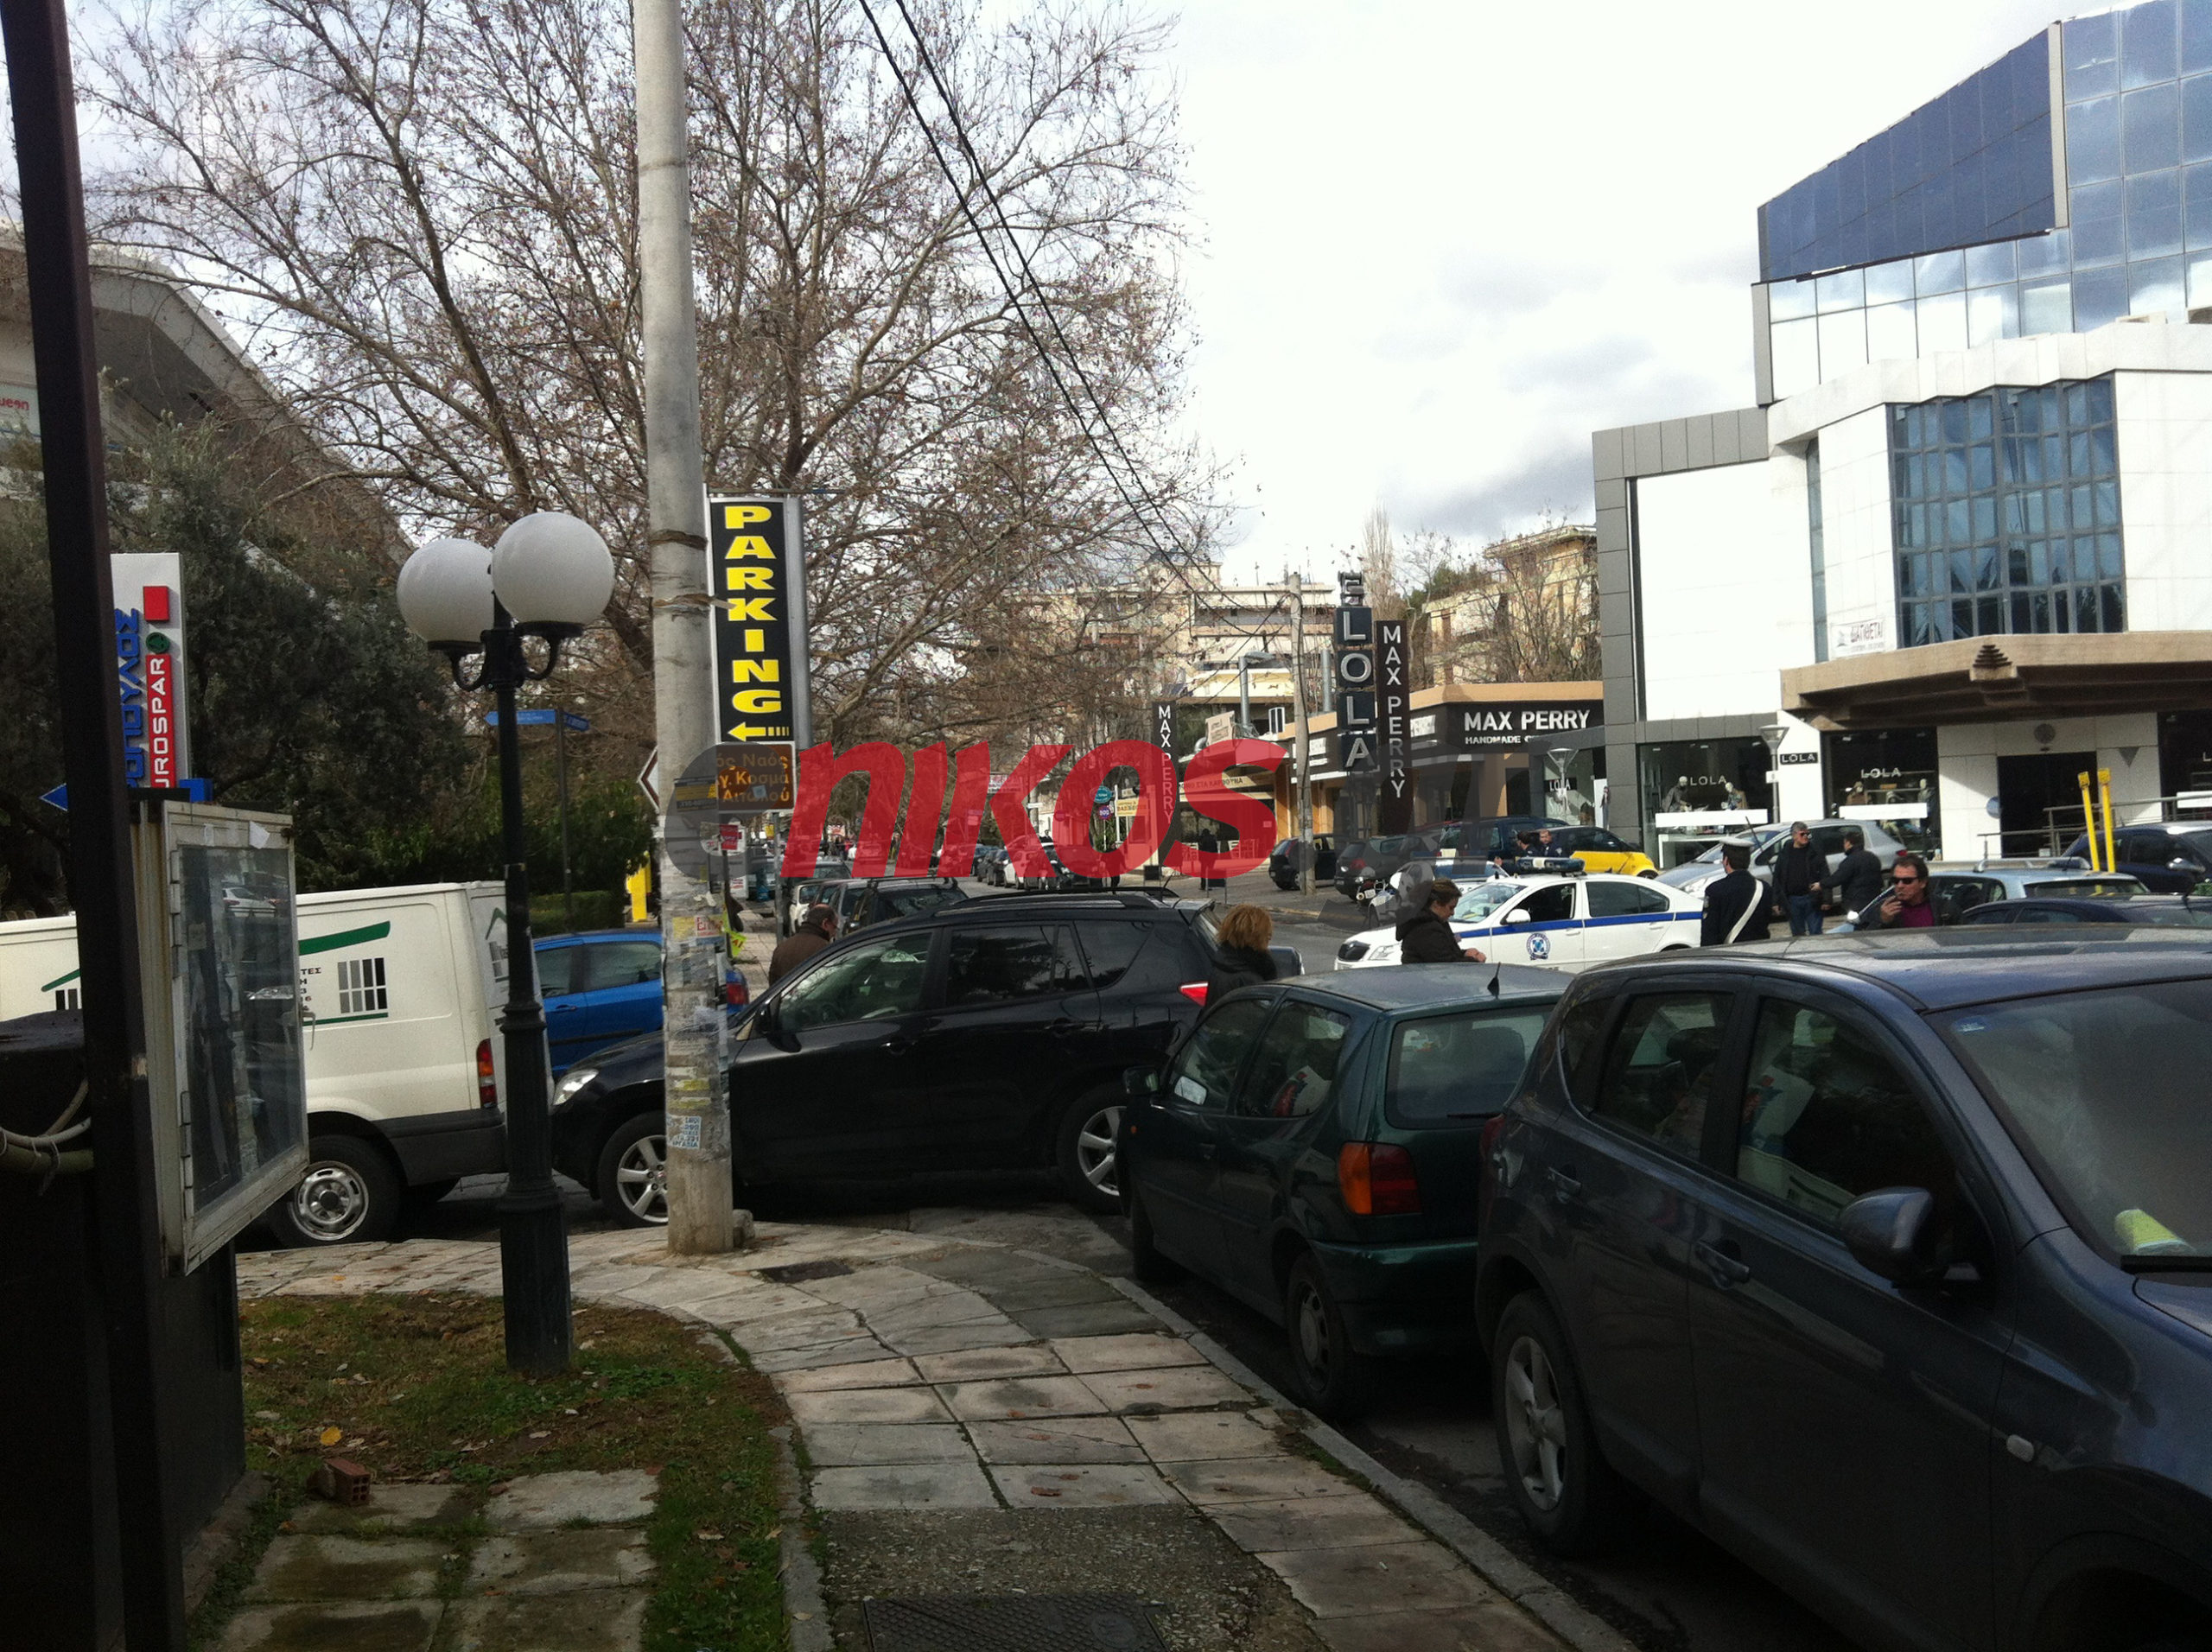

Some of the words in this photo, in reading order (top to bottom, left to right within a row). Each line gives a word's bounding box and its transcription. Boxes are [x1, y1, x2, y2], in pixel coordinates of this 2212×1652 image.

[0, 397, 30, 411] ueen
[724, 505, 782, 714] PARKING
[1382, 625, 1402, 686] MAX
[114, 608, 144, 787] ΟΠΟΥΛΟΣ
[1339, 610, 1376, 769] LOLA
[150, 658, 170, 788] UROSPAR
[1158, 705, 1171, 748] MAX
[1464, 711, 1513, 731] MAX
[1521, 709, 1591, 730] PERRY
[1465, 735, 1521, 745] HANDMADE
[1387, 696, 1407, 799] PERRY
[1782, 753, 1815, 763] LOLA
[1860, 766, 1902, 779] LOLA
[1161, 753, 1174, 824] PERRY
[1689, 774, 1727, 786] LOLA
